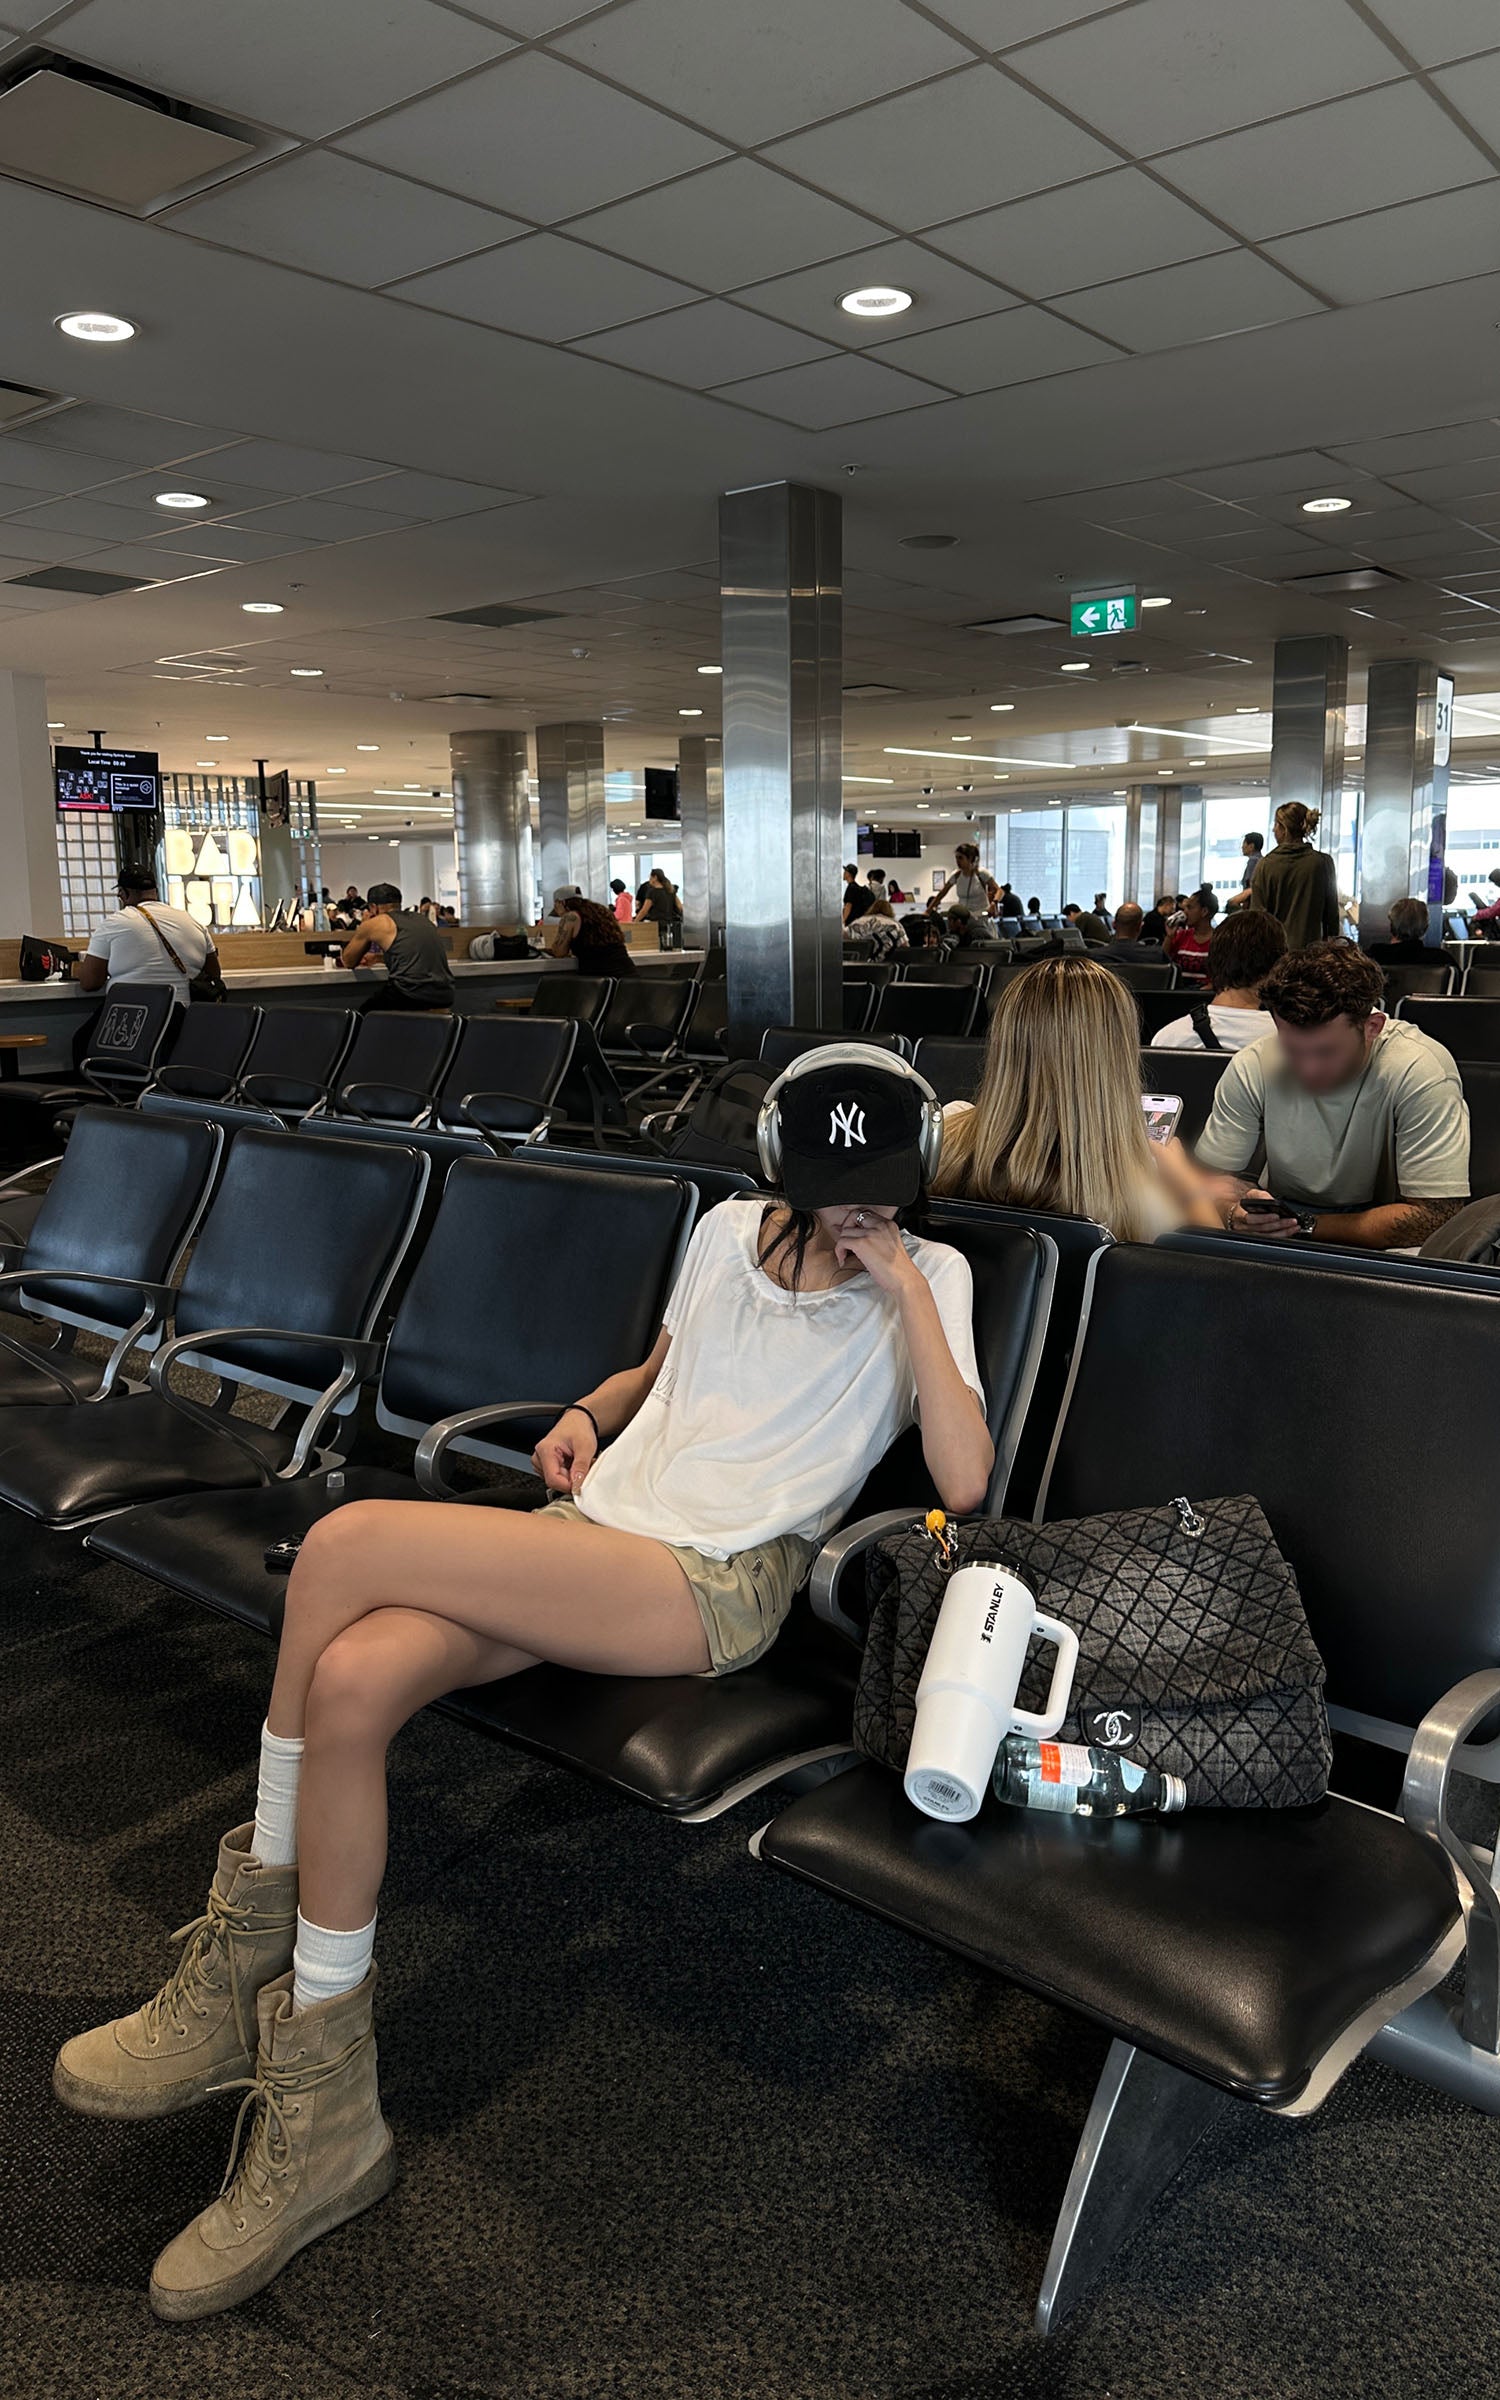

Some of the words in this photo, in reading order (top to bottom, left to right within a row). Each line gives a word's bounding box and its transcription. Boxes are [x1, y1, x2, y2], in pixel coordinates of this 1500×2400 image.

[1437, 702, 1449, 732] 31
[164, 829, 258, 875] BAR
[828, 1102, 867, 1148] NY
[983, 1582, 1005, 1633] STANLEY
